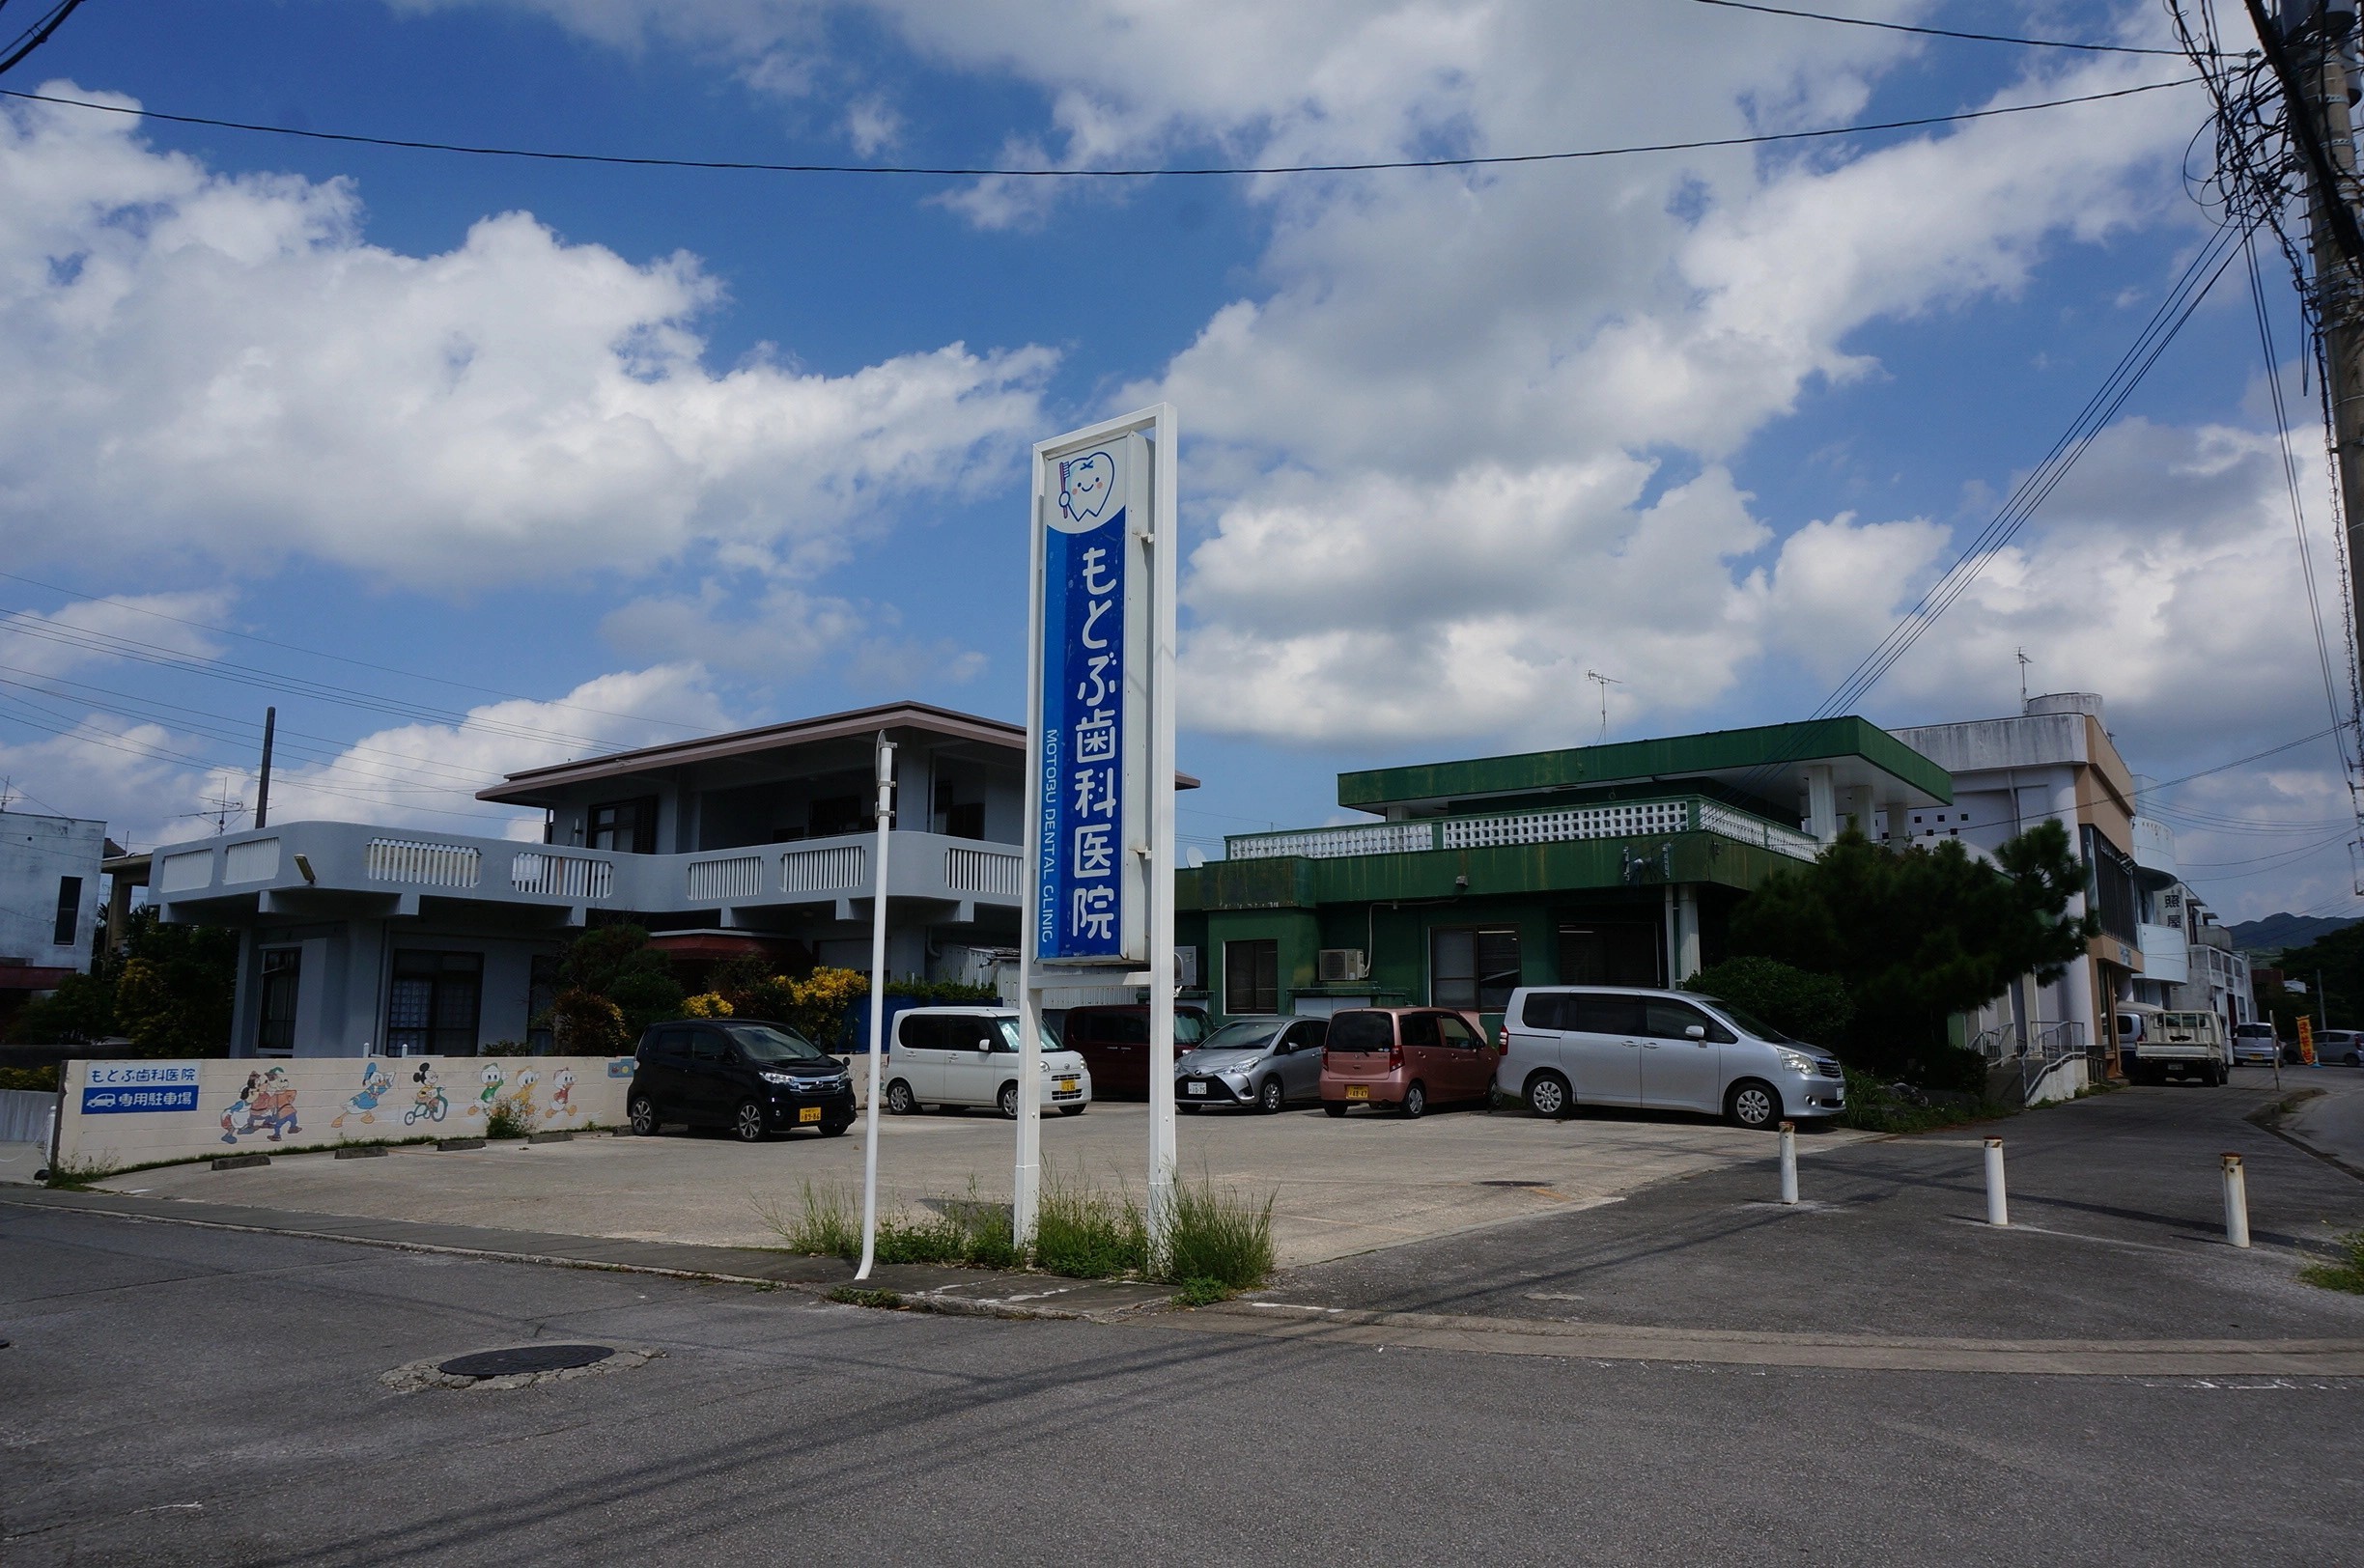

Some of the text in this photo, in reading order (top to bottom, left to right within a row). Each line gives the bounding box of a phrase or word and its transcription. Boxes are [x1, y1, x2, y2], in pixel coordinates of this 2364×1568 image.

[1072, 546, 1117, 939] もとぶ歯科医院
[1042, 729, 1058, 943] MOTOBU DENTAL CLINIC
[2164, 894, 2182, 928] 照屋
[119, 1091, 192, 1106] 専用駐車場
